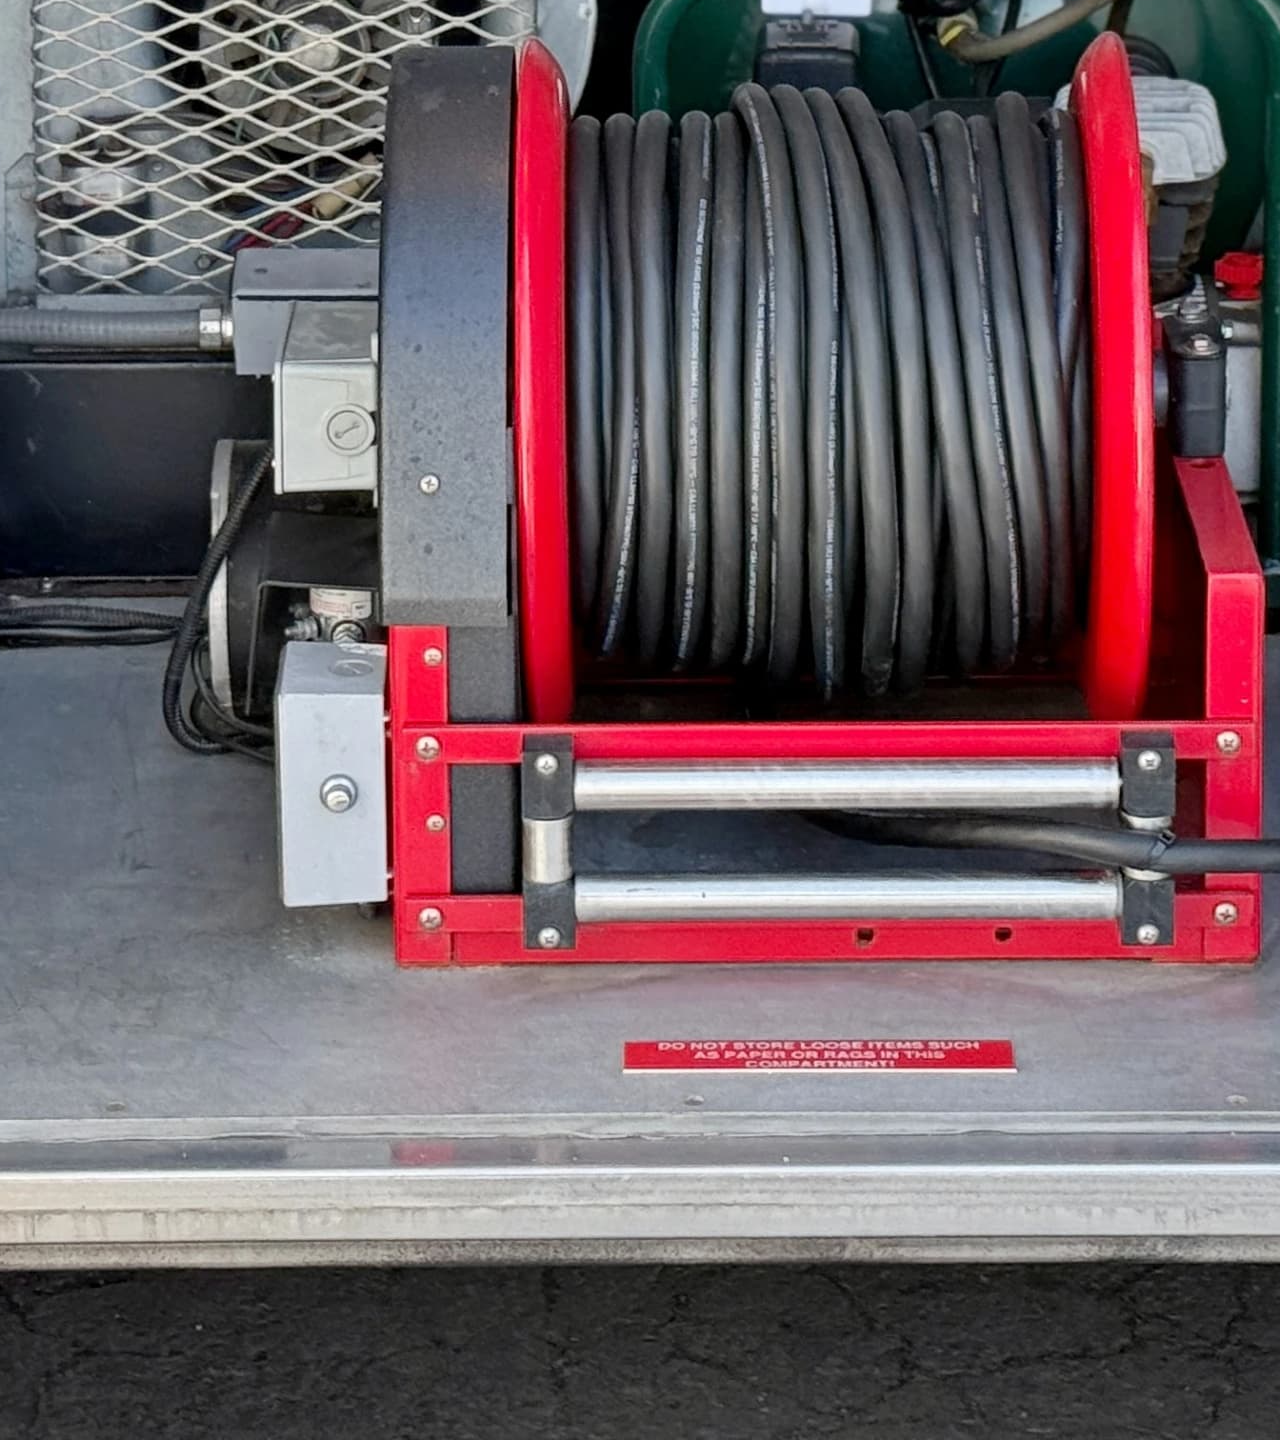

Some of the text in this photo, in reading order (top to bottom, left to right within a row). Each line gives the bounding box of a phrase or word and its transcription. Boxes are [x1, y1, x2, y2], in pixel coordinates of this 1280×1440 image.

[657, 1041, 981, 1051] DO NOT STORE LOOSE ITEMS SUCH
[693, 1050, 946, 1060] AS PAPER OR RAGS IN THIS
[744, 1060, 896, 1069] COMPARTMENT!
